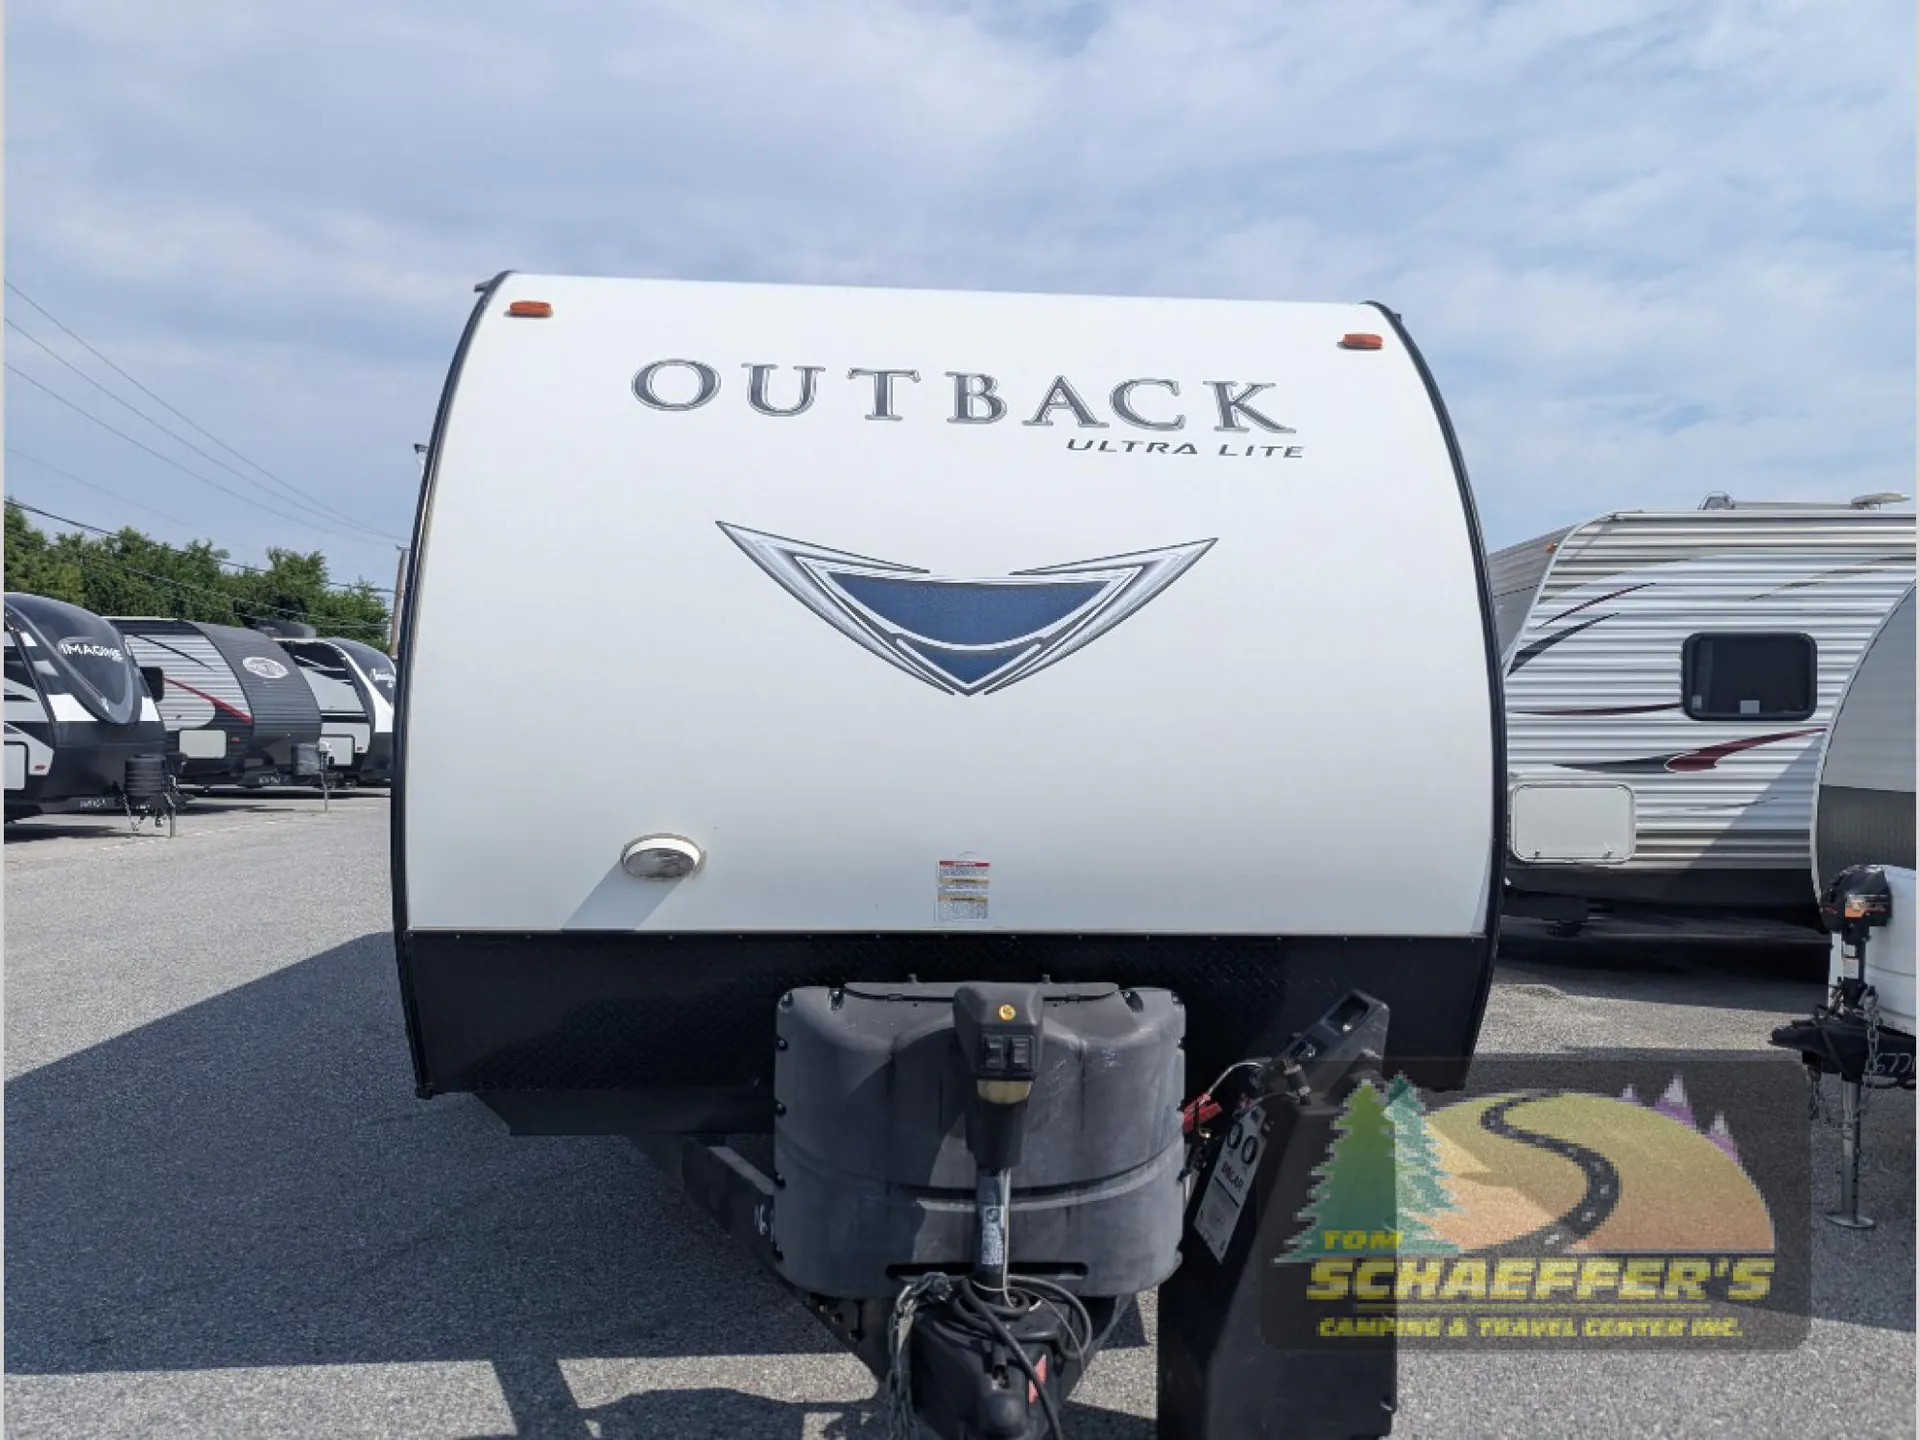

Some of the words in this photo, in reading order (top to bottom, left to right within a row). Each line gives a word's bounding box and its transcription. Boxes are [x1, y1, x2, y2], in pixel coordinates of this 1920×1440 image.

[630, 357, 1297, 435] OUTBACK
[1066, 438, 1199, 455] ULTRA
[1218, 444, 1305, 459] LITE
